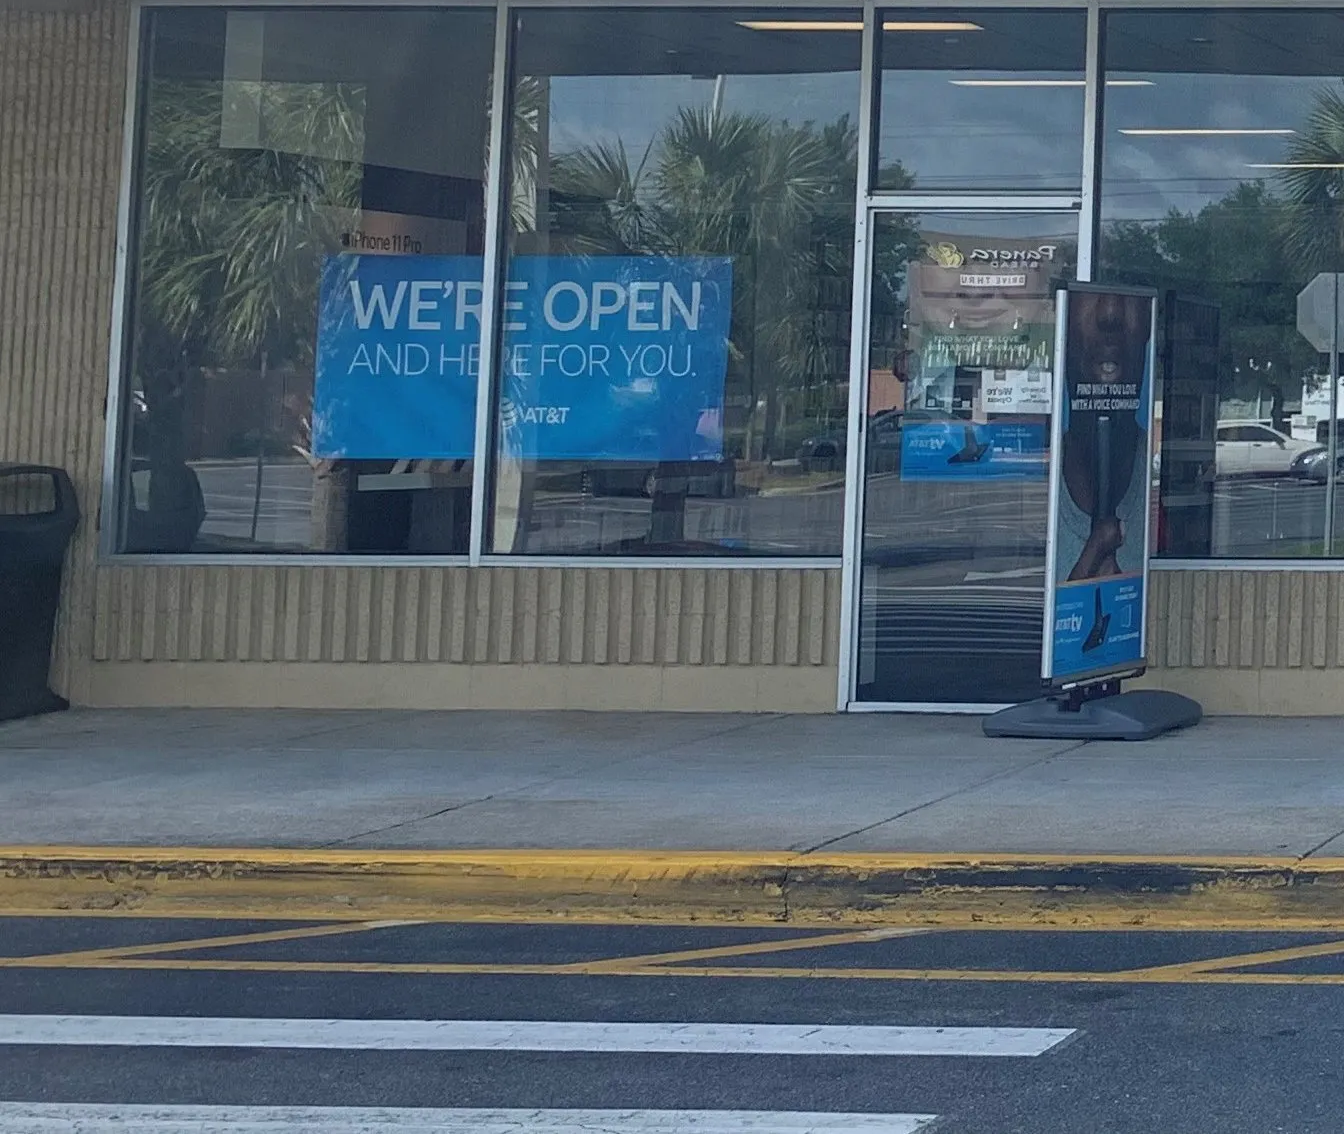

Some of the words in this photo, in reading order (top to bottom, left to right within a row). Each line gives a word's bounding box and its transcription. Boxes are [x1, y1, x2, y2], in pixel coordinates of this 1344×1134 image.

[351, 230, 391, 251] iPhone
[392, 233, 401, 253] 11
[403, 234, 423, 255] Pro
[543, 281, 701, 332] OPEN
[347, 343, 431, 376] AND
[540, 343, 610, 377] FOR
[619, 344, 697, 378] YOU.
[525, 407, 570, 424] AT&T
